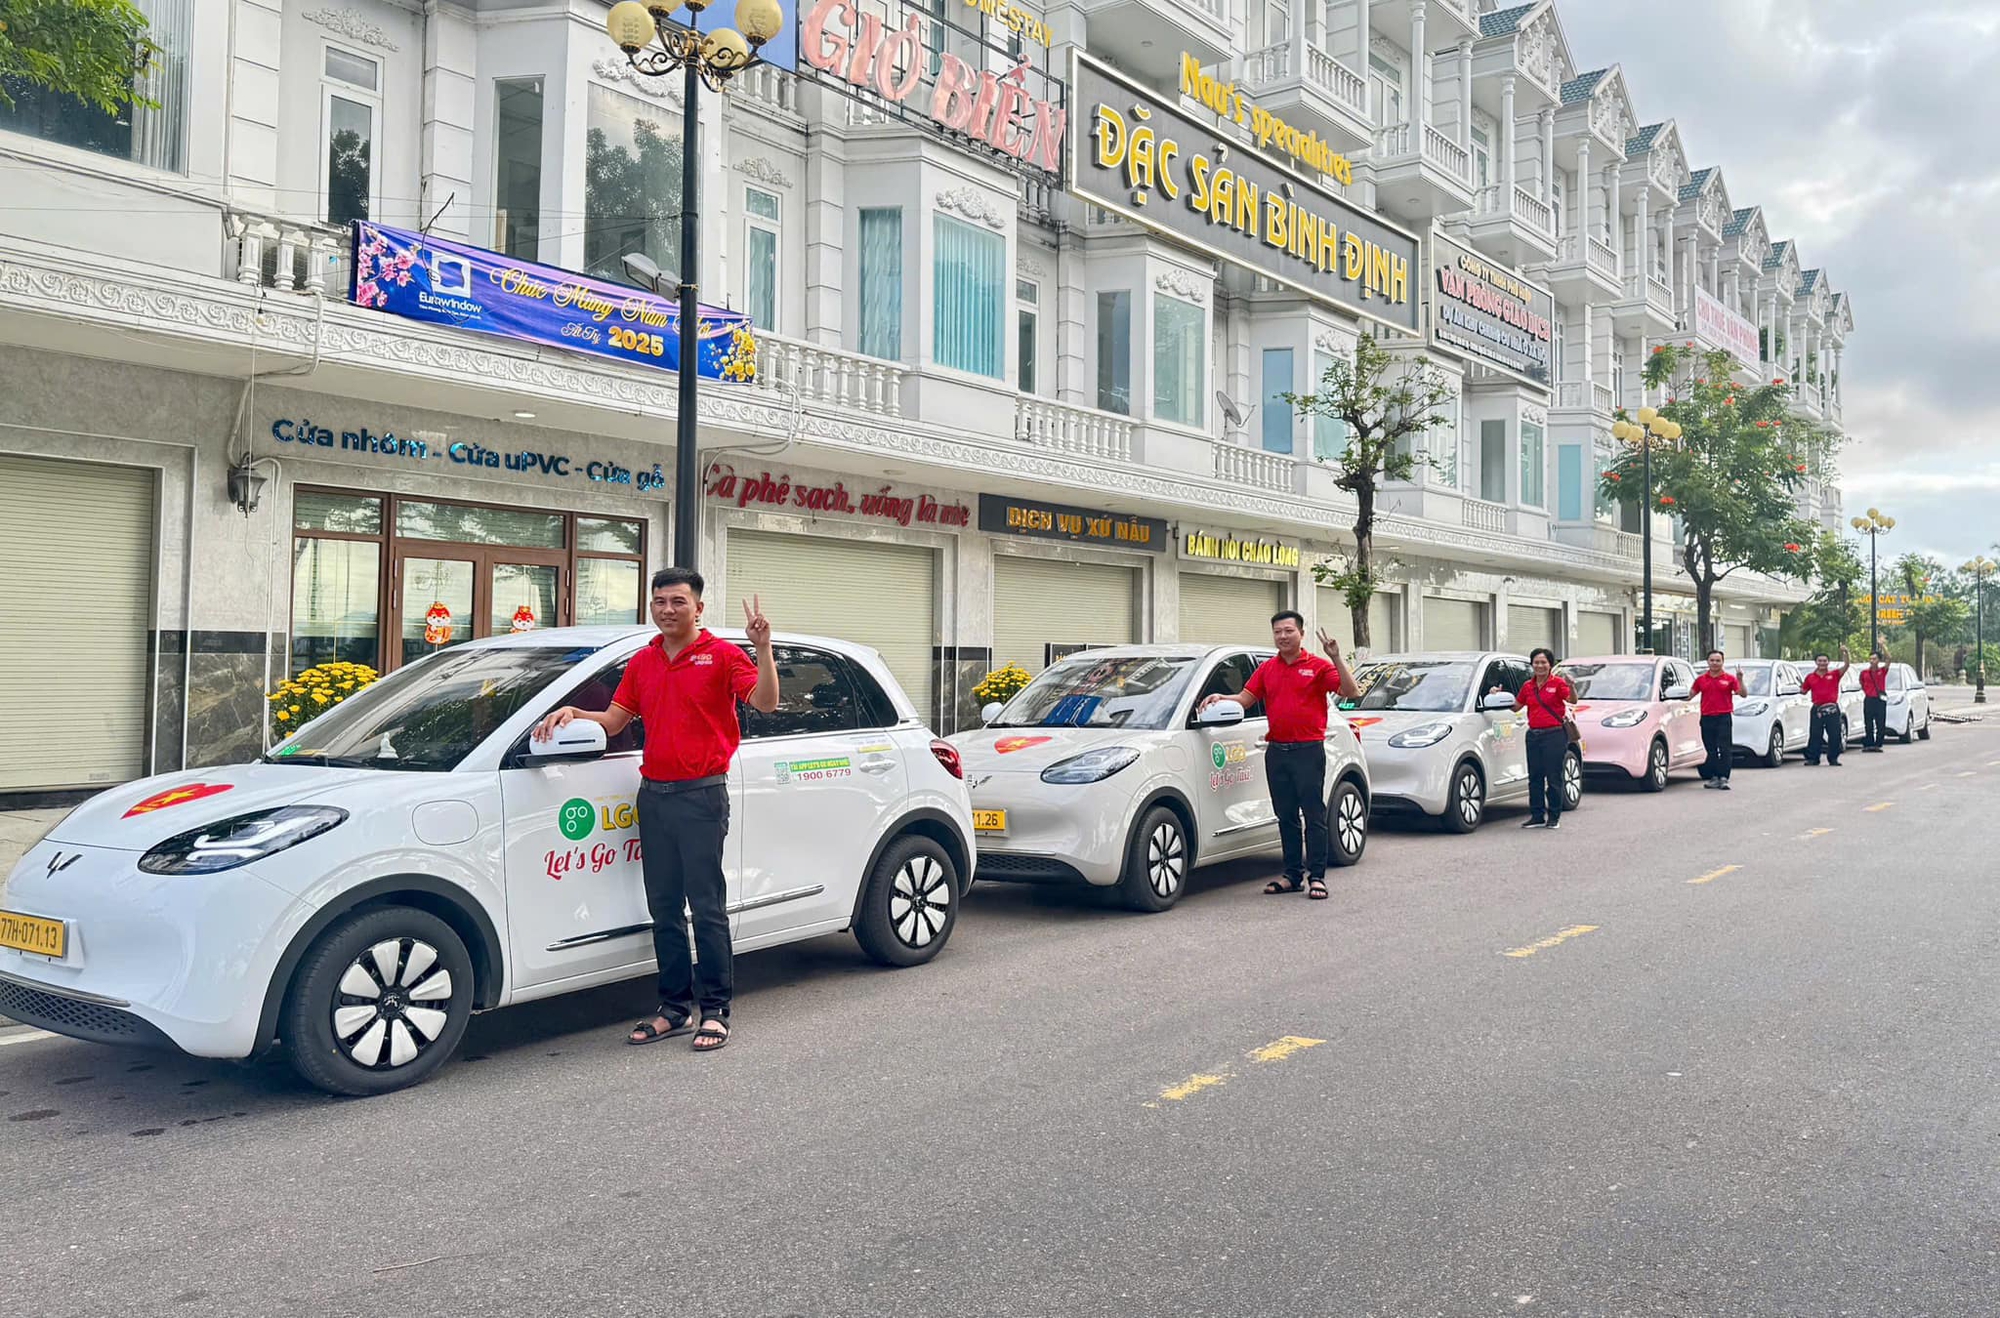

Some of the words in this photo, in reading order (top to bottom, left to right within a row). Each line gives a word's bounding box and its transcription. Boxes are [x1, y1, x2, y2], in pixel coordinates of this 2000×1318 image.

[931, 53, 1066, 172] BIỂN
[1094, 102, 1179, 205] ĐẶC
[1187, 144, 1258, 238] SẢN
[1264, 182, 1337, 273] BÌNH
[1340, 231, 1408, 304] ĐỊNH
[419, 291, 482, 313] Eurowindow
[490, 267, 547, 299] Chúc
[553, 283, 615, 322] Mừng
[620, 297, 669, 328] Năm
[1440, 264, 1464, 301] VĂN
[1466, 280, 1502, 318] PHÒNG
[1502, 299, 1527, 331] GIAO
[1528, 311, 1550, 342] DỊCH
[608, 325, 664, 357] 2025
[272, 418, 334, 447] Cửa
[342, 428, 427, 459] nhôm
[449, 441, 499, 468] Cửa
[505, 450, 569, 476] uPVC
[587, 461, 631, 484] Cửa
[637, 463, 665, 492] gỗ
[739, 472, 790, 508] phê
[861, 486, 914, 527] uống
[1007, 506, 1053, 533] DỊCH
[1057, 513, 1083, 539] VỤ
[1187, 530, 1219, 557] BÁNH
[1242, 538, 1271, 564] CHÁO
[1272, 540, 1299, 567] LÒNG
[798, 771, 823, 781] 1900
[826, 769, 851, 778] 6779
[973, 812, 998, 826] 1.26
[544, 846, 585, 880] Let's
[591, 843, 617, 873] Go
